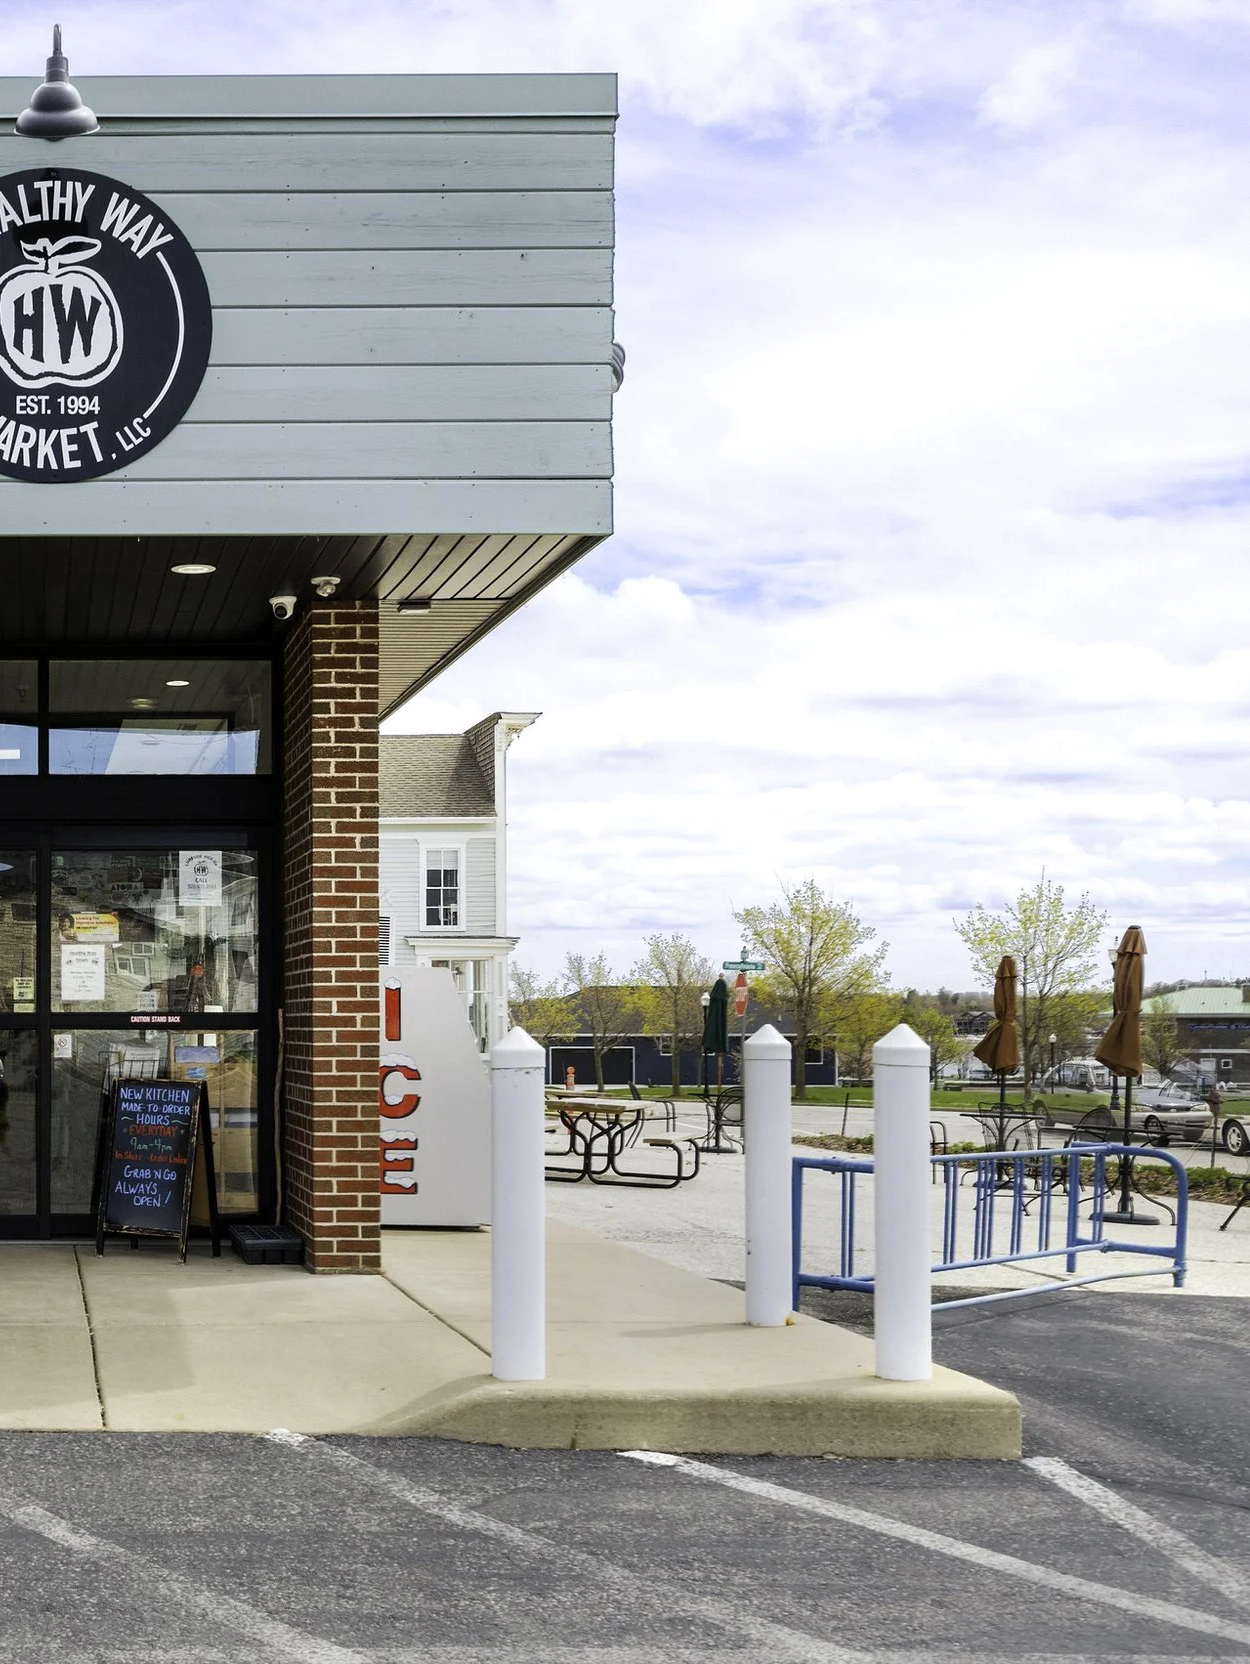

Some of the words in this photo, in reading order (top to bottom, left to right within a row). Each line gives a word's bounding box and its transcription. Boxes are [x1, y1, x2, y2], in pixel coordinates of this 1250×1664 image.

[100, 191, 174, 260] WAY
[13, 283, 103, 366] HW
[15, 396, 52, 415] EST.
[57, 396, 101, 415] 1994
[115, 416, 152, 452] LLC
[120, 1087, 144, 1100] NEW
[146, 1088, 190, 1103] KITCHEN
[136, 1114, 170, 1126] HOURS
[130, 1125, 179, 1136] EVERYDAY
[124, 1165, 151, 1179] GRAB
[163, 1169, 177, 1180] GO
[114, 1180, 158, 1195] ALWAYS
